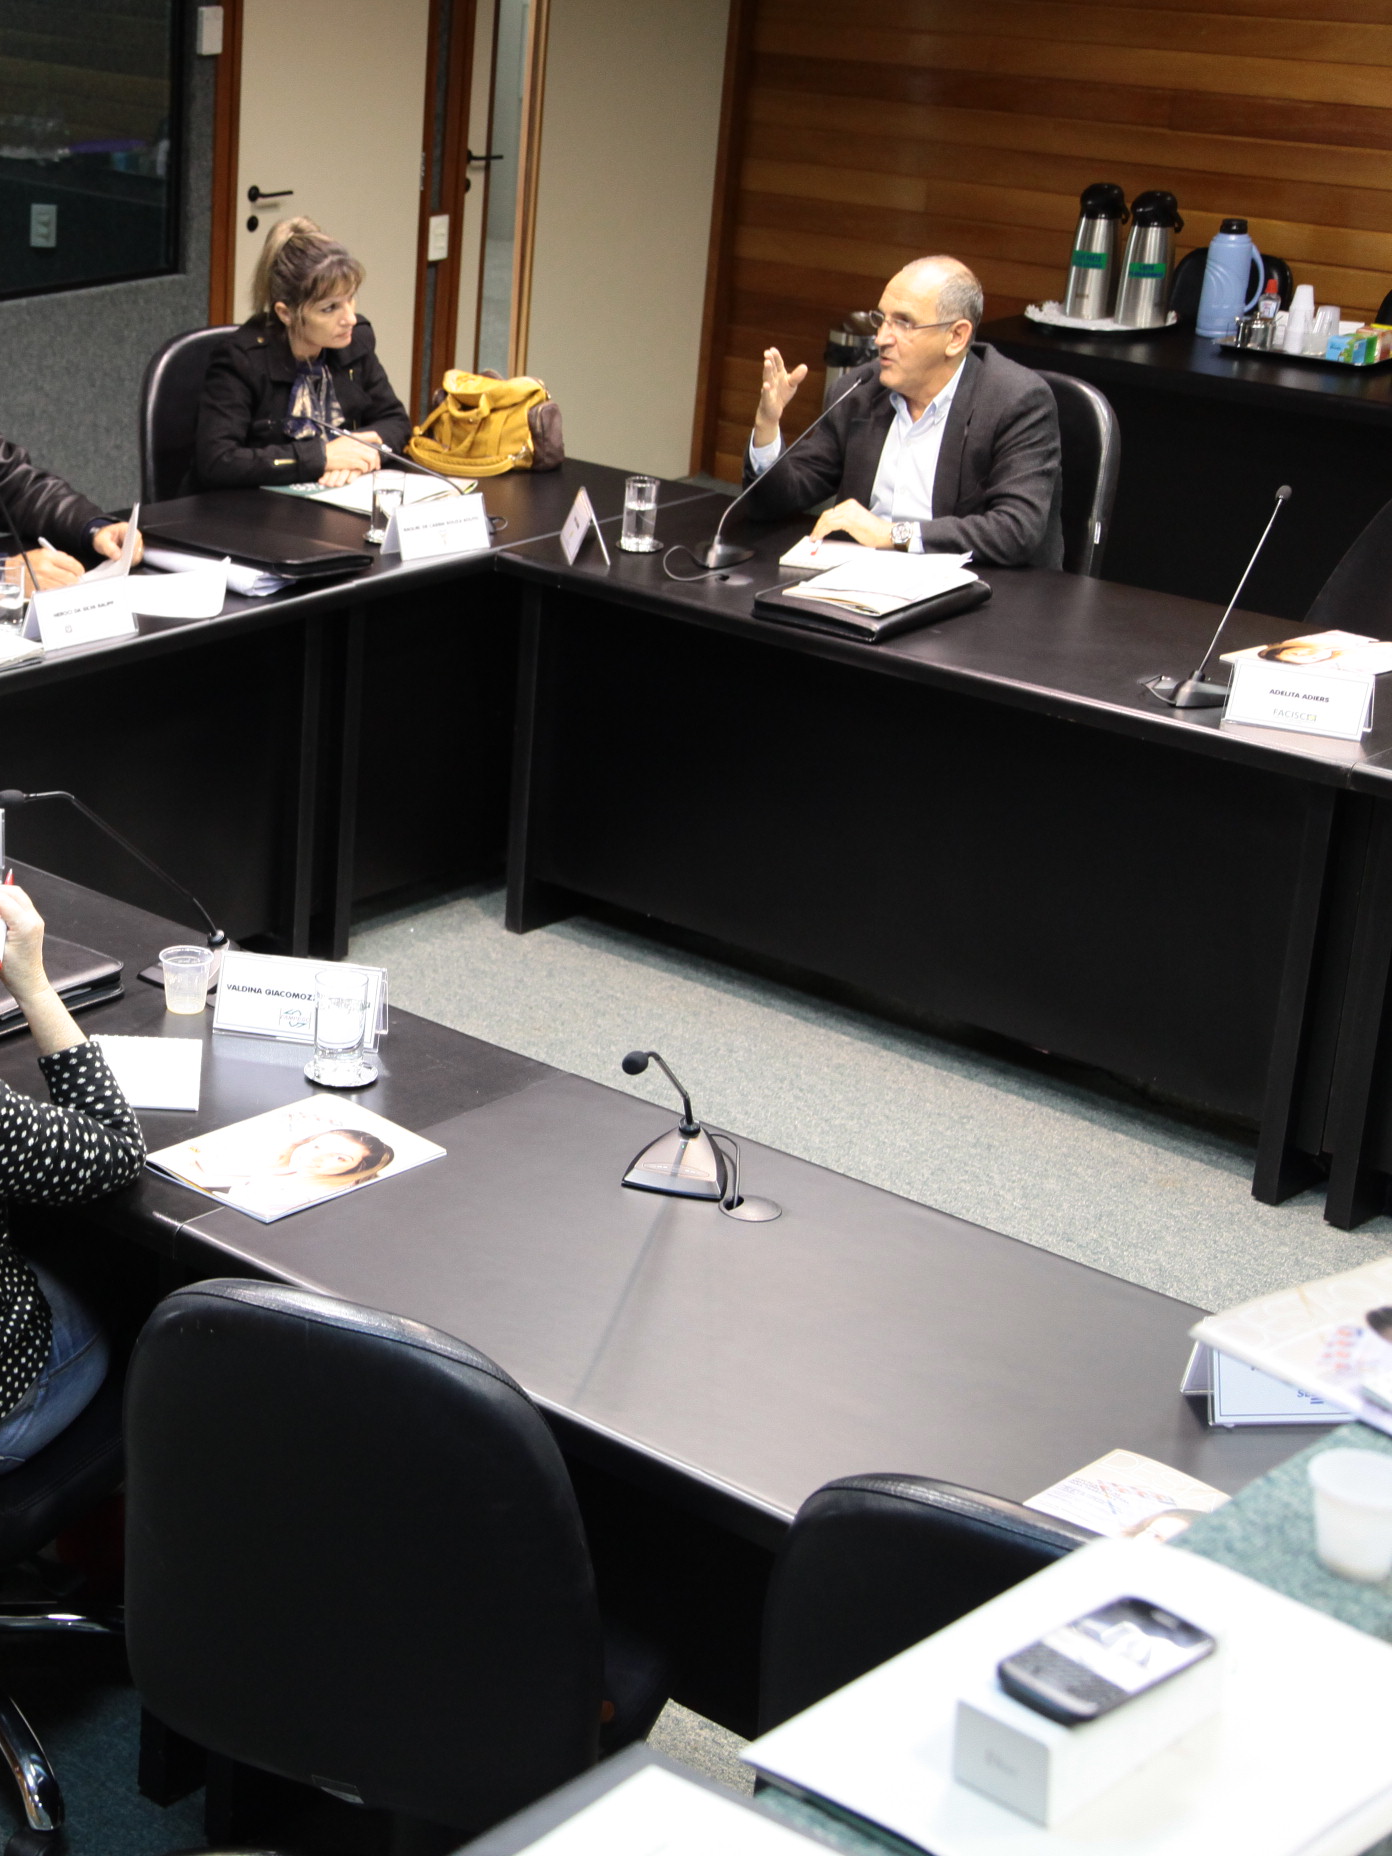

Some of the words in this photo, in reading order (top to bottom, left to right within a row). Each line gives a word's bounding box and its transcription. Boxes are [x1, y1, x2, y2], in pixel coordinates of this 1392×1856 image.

[1269, 688, 1300, 698] ADELITA
[1302, 693, 1330, 702] ADIERS
[226, 983, 263, 994] VALDINA
